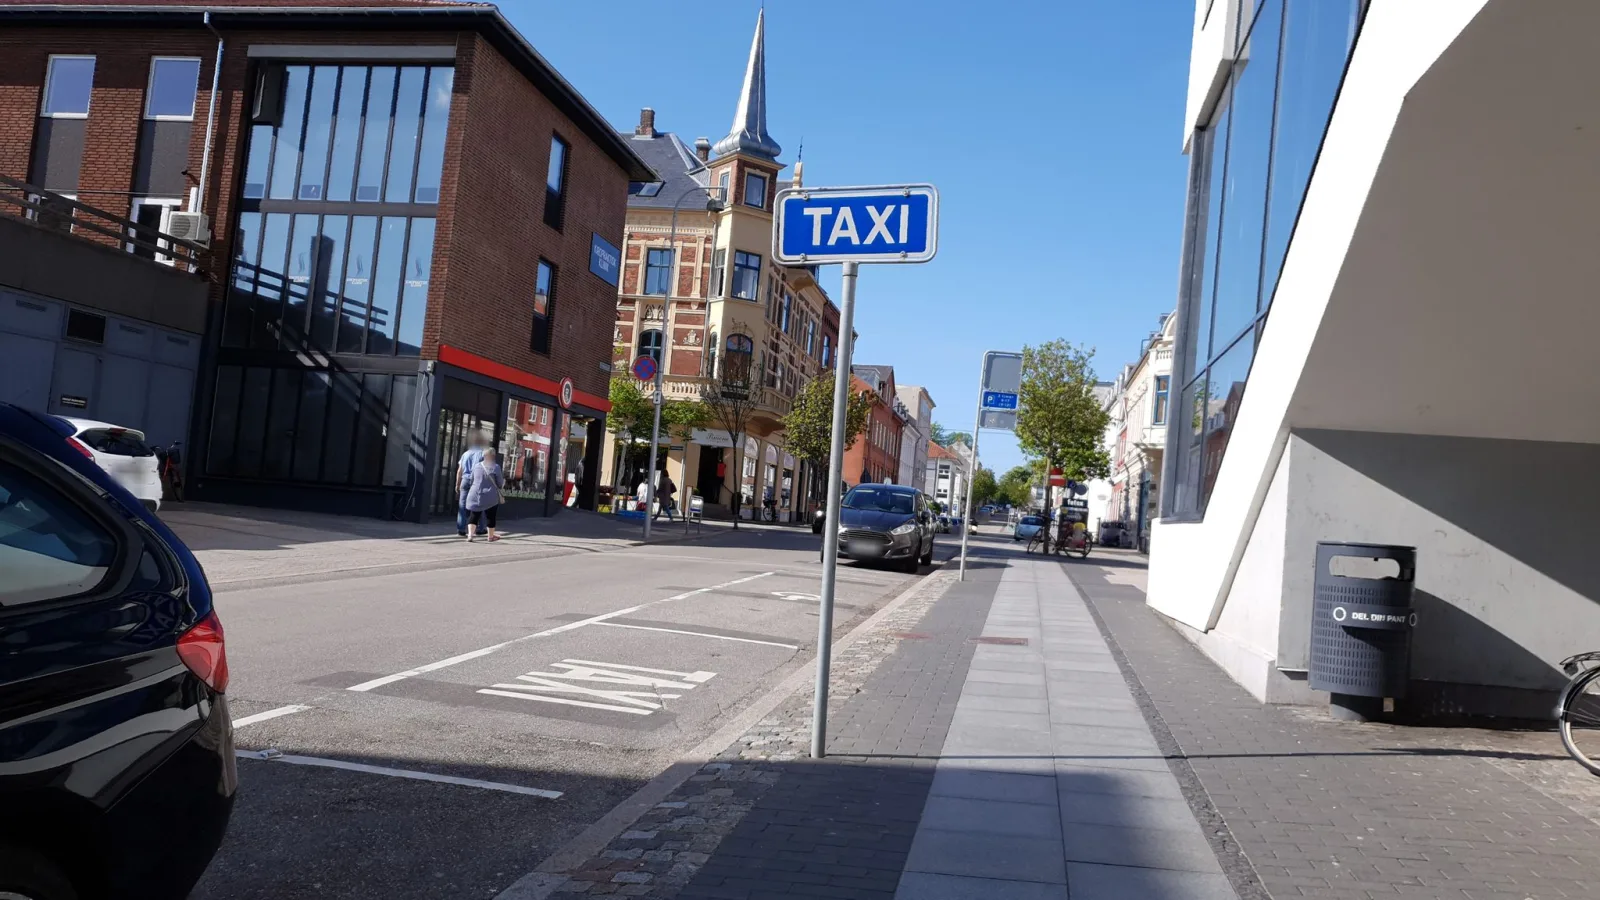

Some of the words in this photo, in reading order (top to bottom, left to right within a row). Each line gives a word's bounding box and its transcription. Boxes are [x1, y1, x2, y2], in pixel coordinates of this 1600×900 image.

[803, 204, 910, 246] TAXI
[1351, 612, 1369, 621] DEL
[1370, 613, 1386, 622] DIN
[1387, 615, 1406, 623] PANT
[476, 658, 718, 715] TAXI
